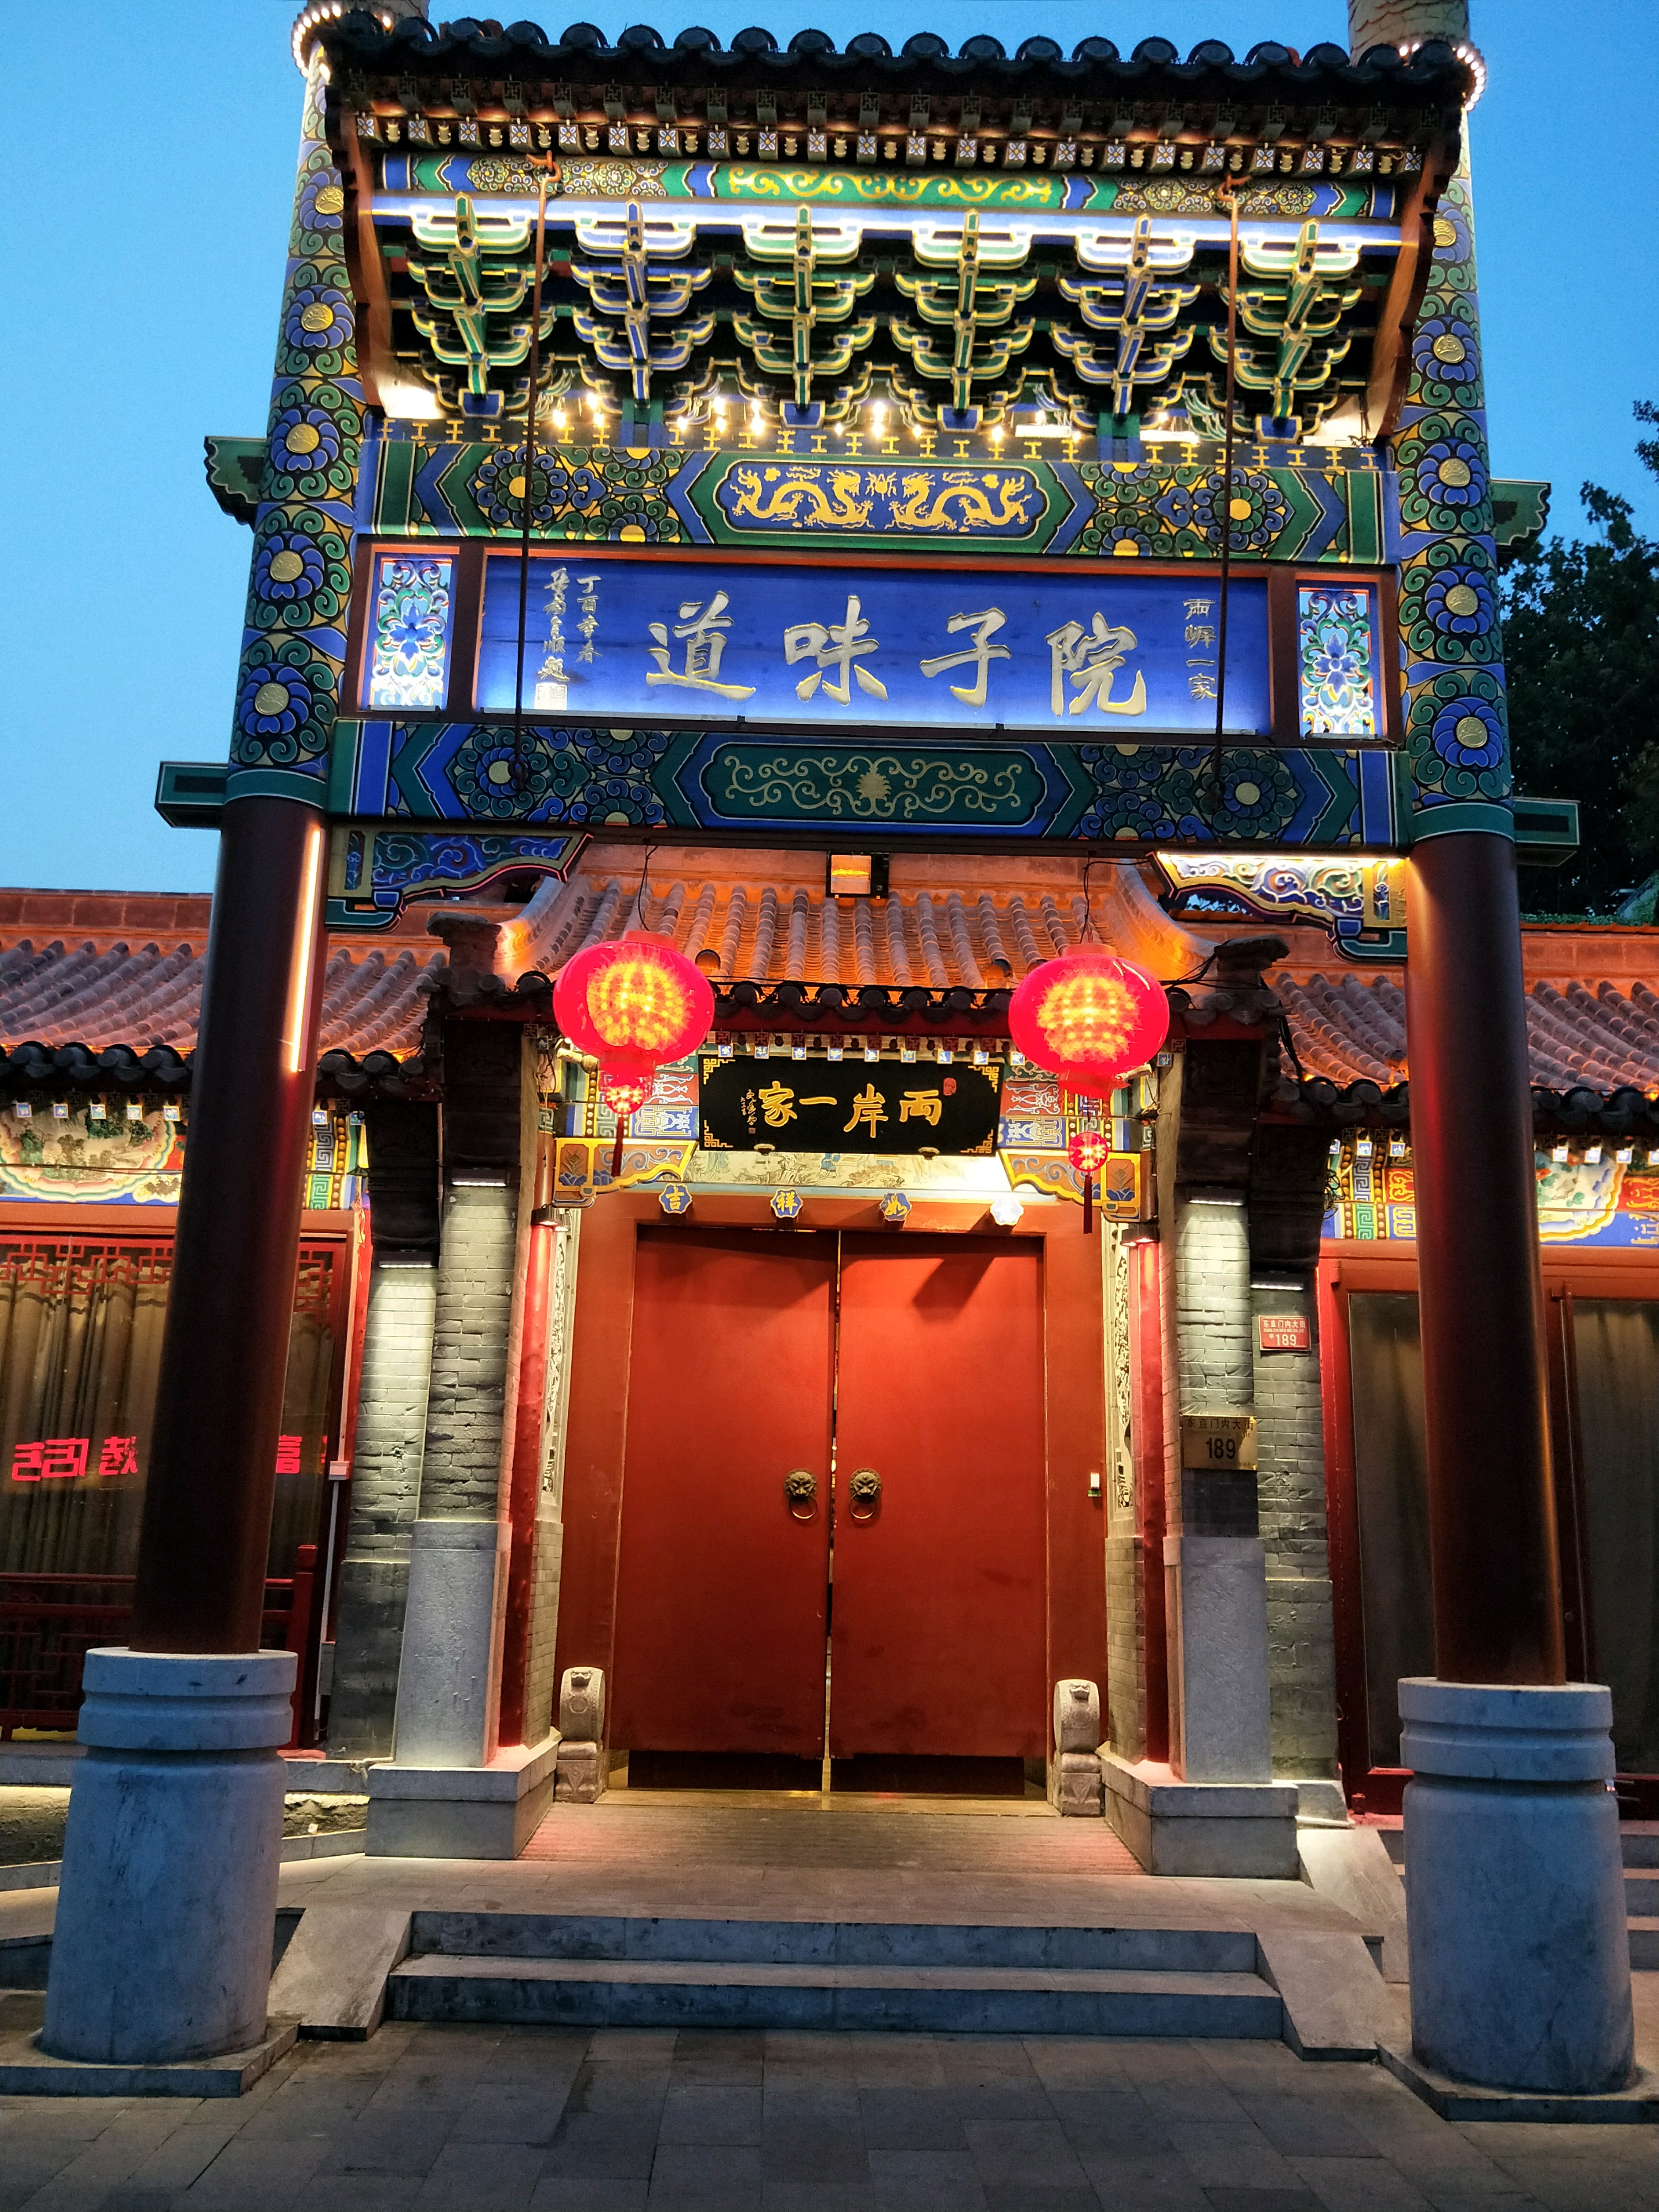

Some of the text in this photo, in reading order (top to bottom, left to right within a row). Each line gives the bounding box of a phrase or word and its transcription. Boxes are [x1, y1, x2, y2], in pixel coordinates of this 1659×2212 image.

[1263, 1320, 1306, 1328] 东直门内大街
[1276, 1334, 1296, 1346] 189
[1187, 1417, 1253, 1430] 东直门内大街
[1206, 1438, 1236, 1459] 189
